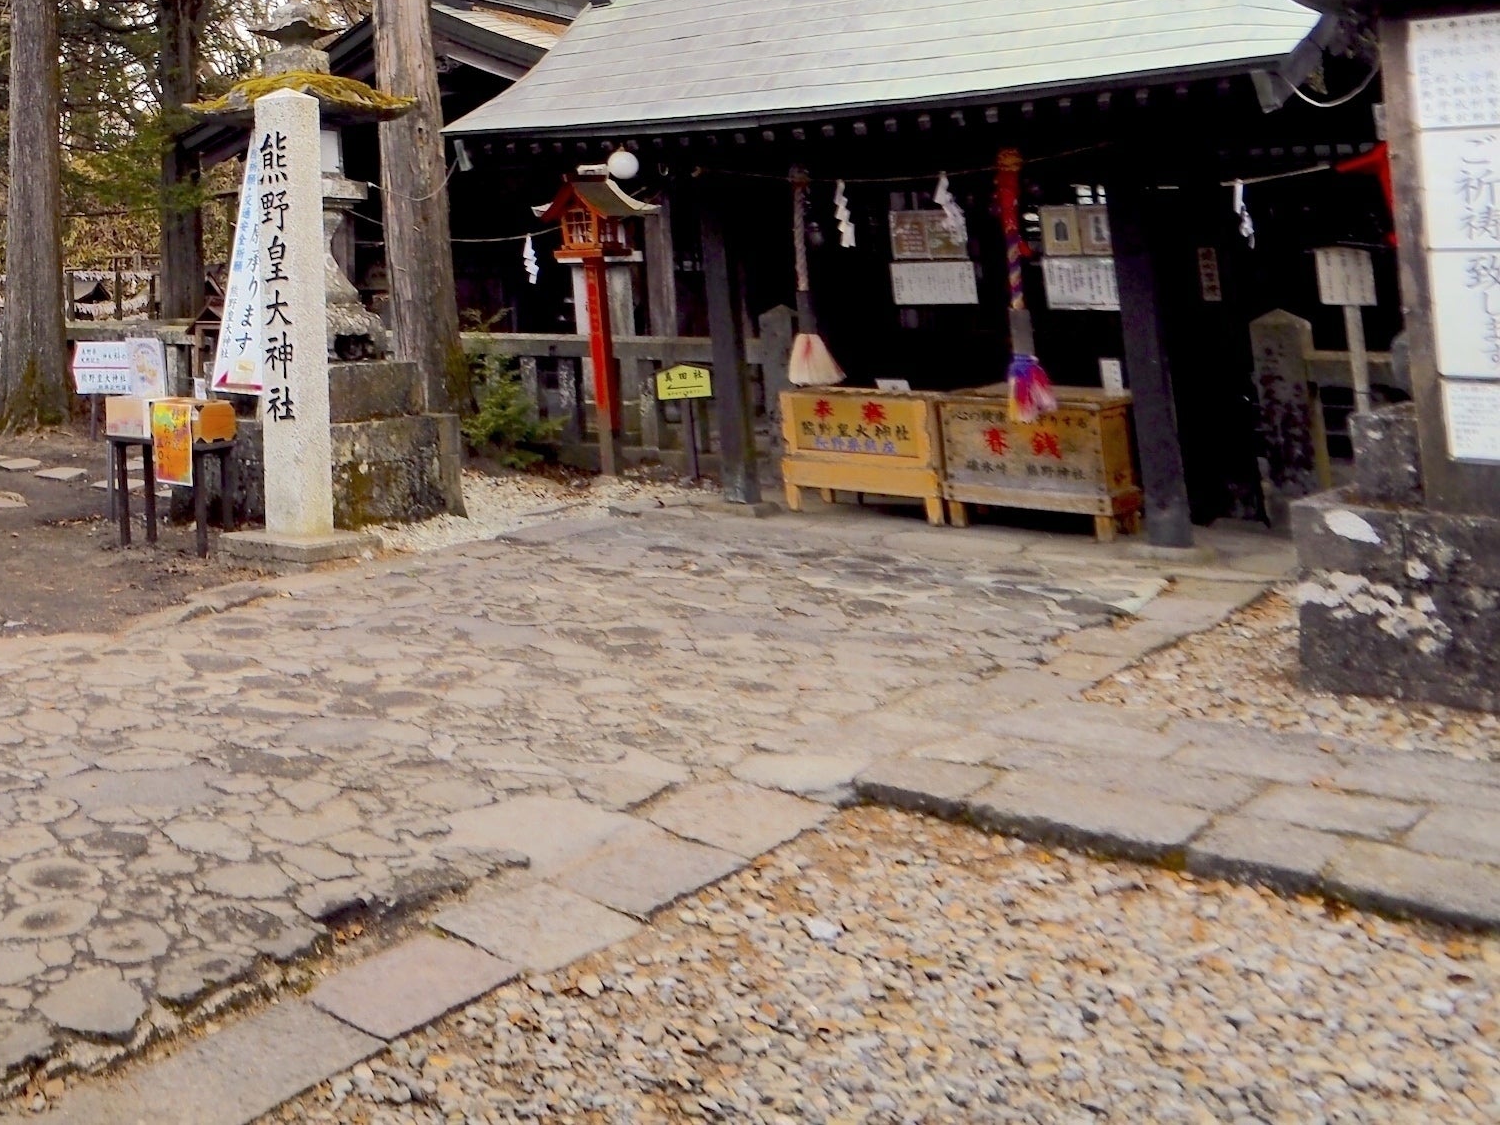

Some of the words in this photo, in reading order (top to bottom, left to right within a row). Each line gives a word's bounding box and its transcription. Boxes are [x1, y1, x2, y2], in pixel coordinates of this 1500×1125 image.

[259, 131, 296, 421] 熊野皇大神社
